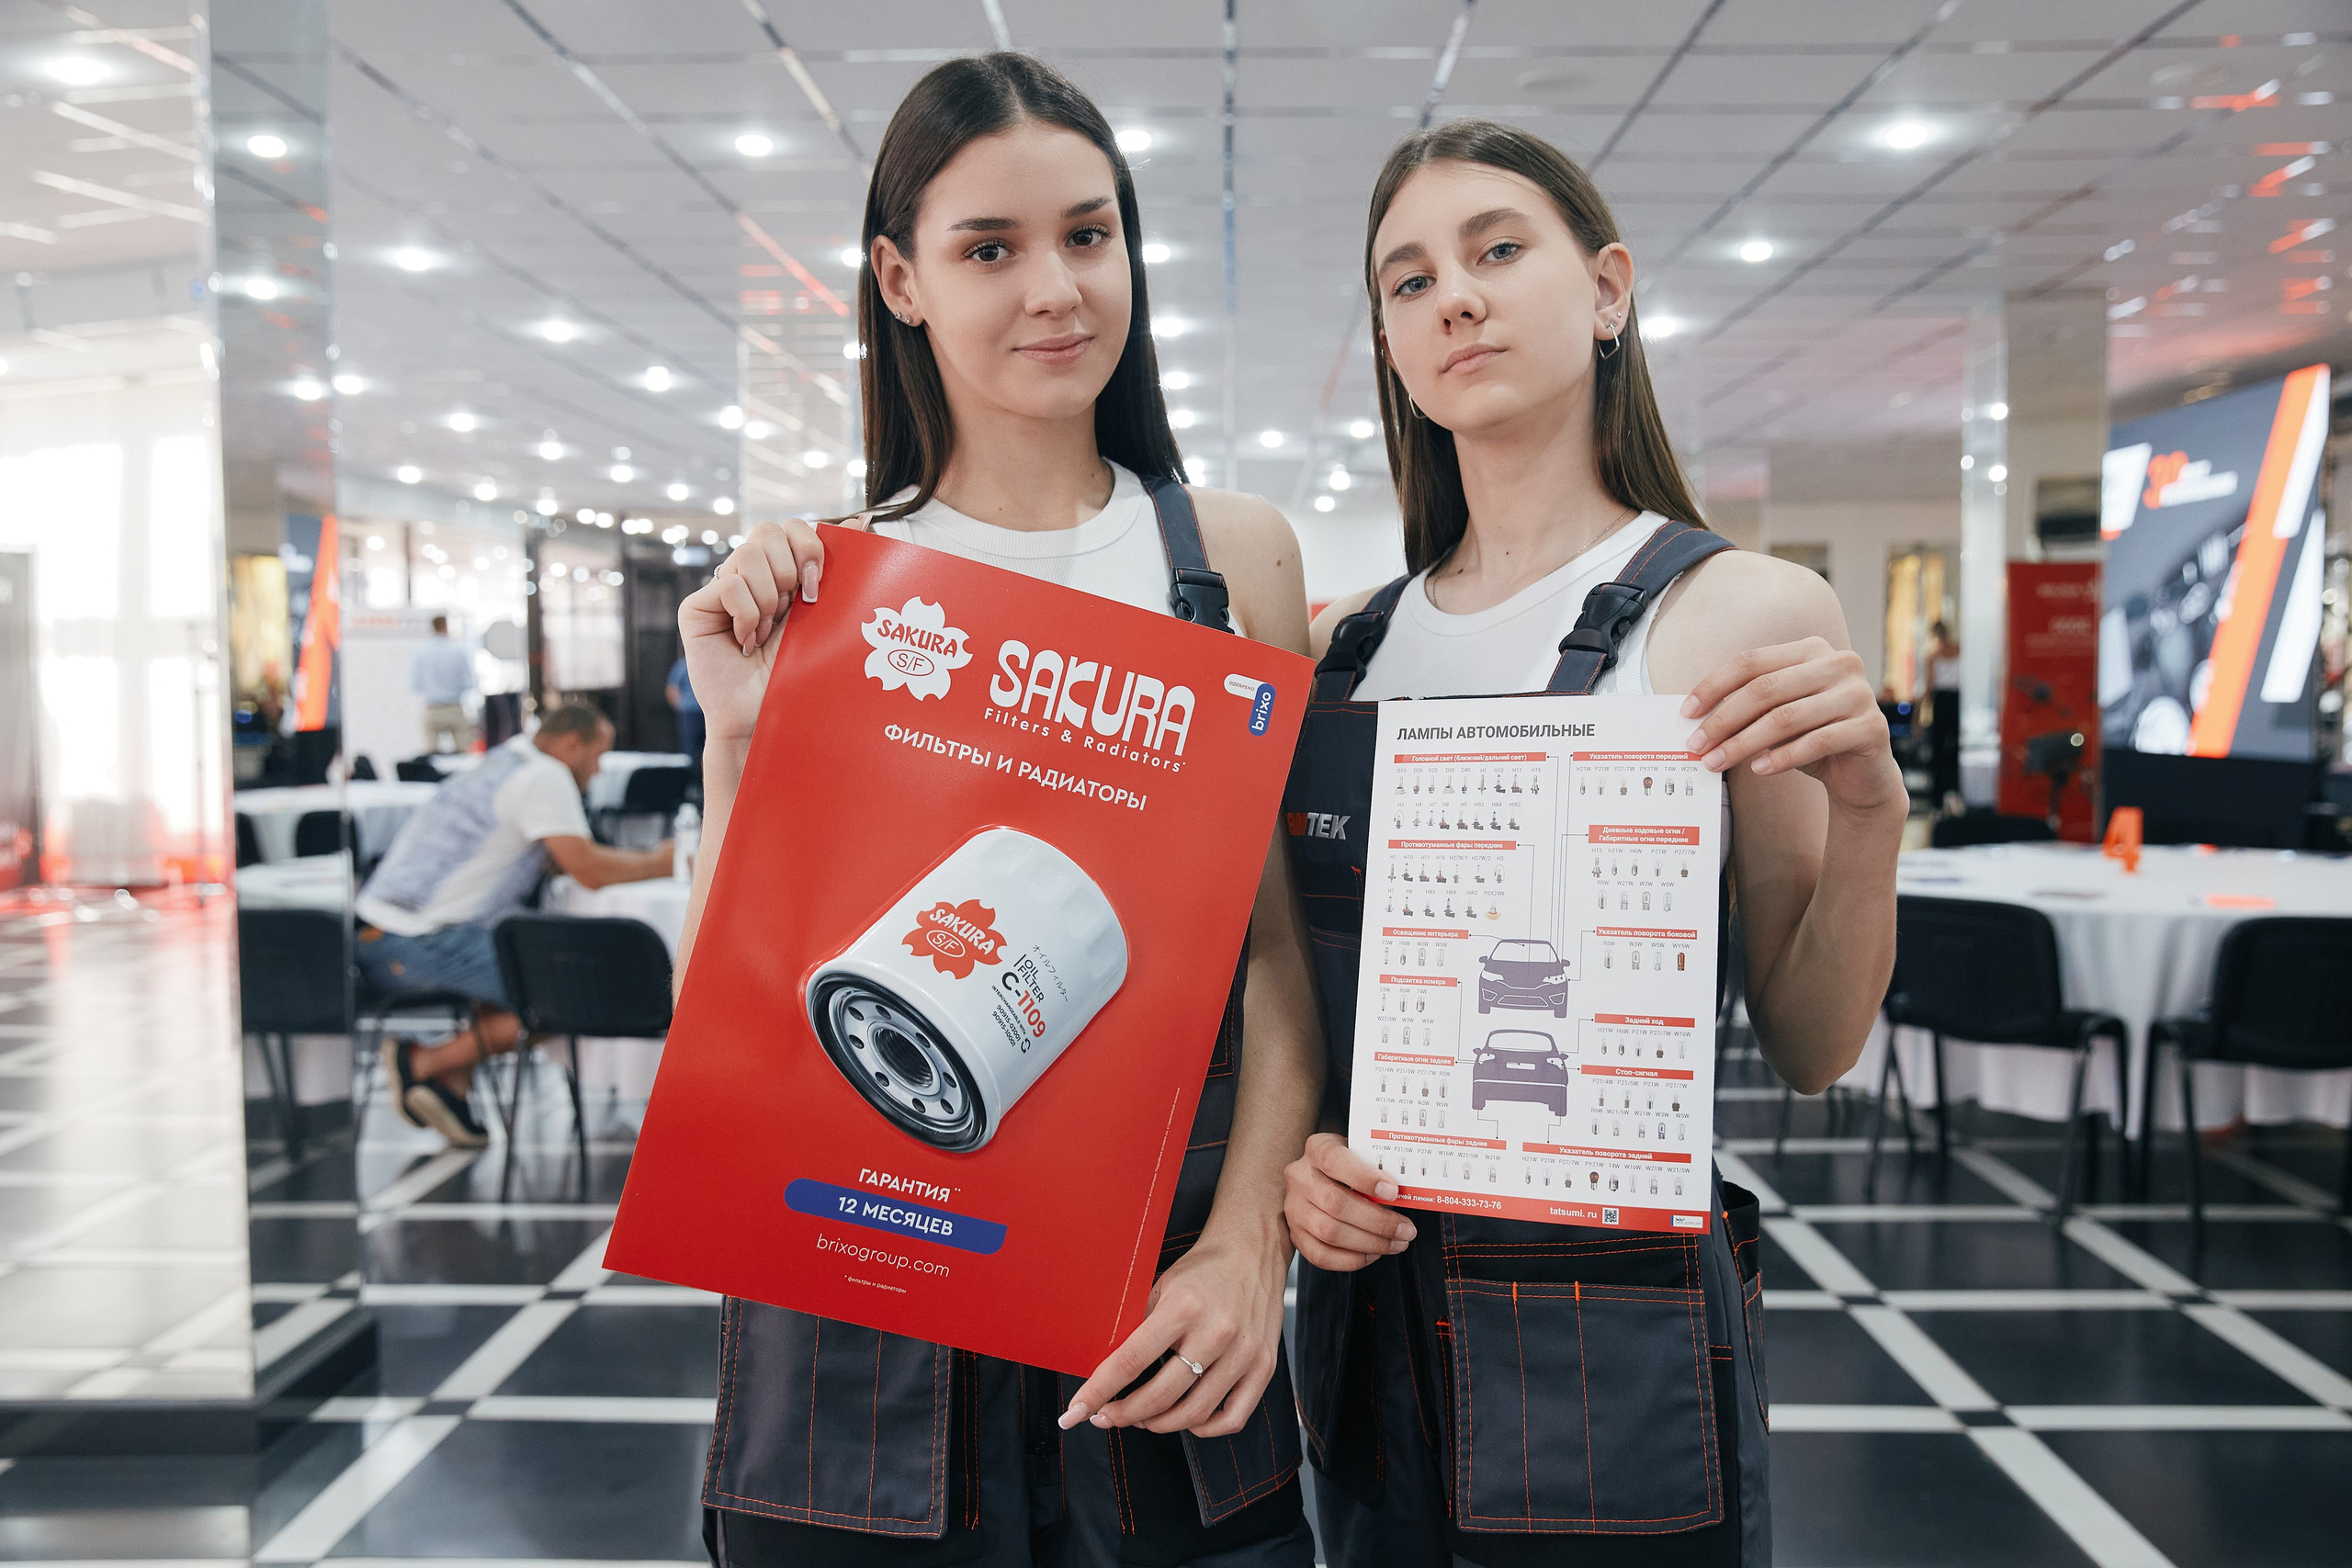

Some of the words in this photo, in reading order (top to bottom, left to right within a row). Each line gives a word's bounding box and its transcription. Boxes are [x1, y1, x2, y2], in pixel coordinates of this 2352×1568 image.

[877, 619, 957, 658] SAKURA
[896, 653, 924, 671] S/F
[989, 639, 1195, 757] SAKURA
[1229, 681, 1255, 691] ОДОБРЕНО
[984, 707, 1050, 737] Filters
[1060, 729, 1072, 743] &
[1251, 692, 1272, 731] brixo
[1397, 727, 1453, 740] ЛАМПЫ
[1456, 723, 1595, 739] АВТОМОБИЛЬНЫЕ
[884, 724, 991, 767] ФИЛЬТРЫ
[997, 754, 1013, 773] И
[1017, 761, 1147, 811] РАДИАТОРЫ
[929, 908, 995, 955] SAKURA
[933, 933, 959, 950] S/F
[1017, 965, 1045, 1003] FILTER
[1024, 959, 1038, 980] OIL
[1033, 944, 1068, 1002] オイルフィルター
[1391, 976, 1422, 984] Подсветка
[991, 985, 1021, 1024] INTERCHANGEABLE
[1001, 972, 1046, 1038] C-1109
[991, 1011, 1016, 1047] 90915-10001
[996, 1005, 1022, 1042] 90915-03001
[1616, 1068, 1658, 1077] Стоп-сигнал
[1389, 1133, 1445, 1143] Противотуманные
[1559, 1147, 1593, 1155] Указатель
[1595, 1150, 1626, 1158] поворота
[1628, 1152, 1652, 1160] задний
[858, 1168, 951, 1202] ГАРАНТИЯ
[1437, 1196, 1501, 1209] 8-804-333-73-76
[838, 1197, 858, 1214] 12
[862, 1201, 953, 1236] МЕСЯЦЕВ
[1550, 1206, 1585, 1218] tatsumi.
[1588, 1210, 1597, 1218] ru
[817, 1233, 950, 1278] brixogroup.com
[848, 1276, 871, 1286] фильтры
[876, 1283, 906, 1293] радиаторы
